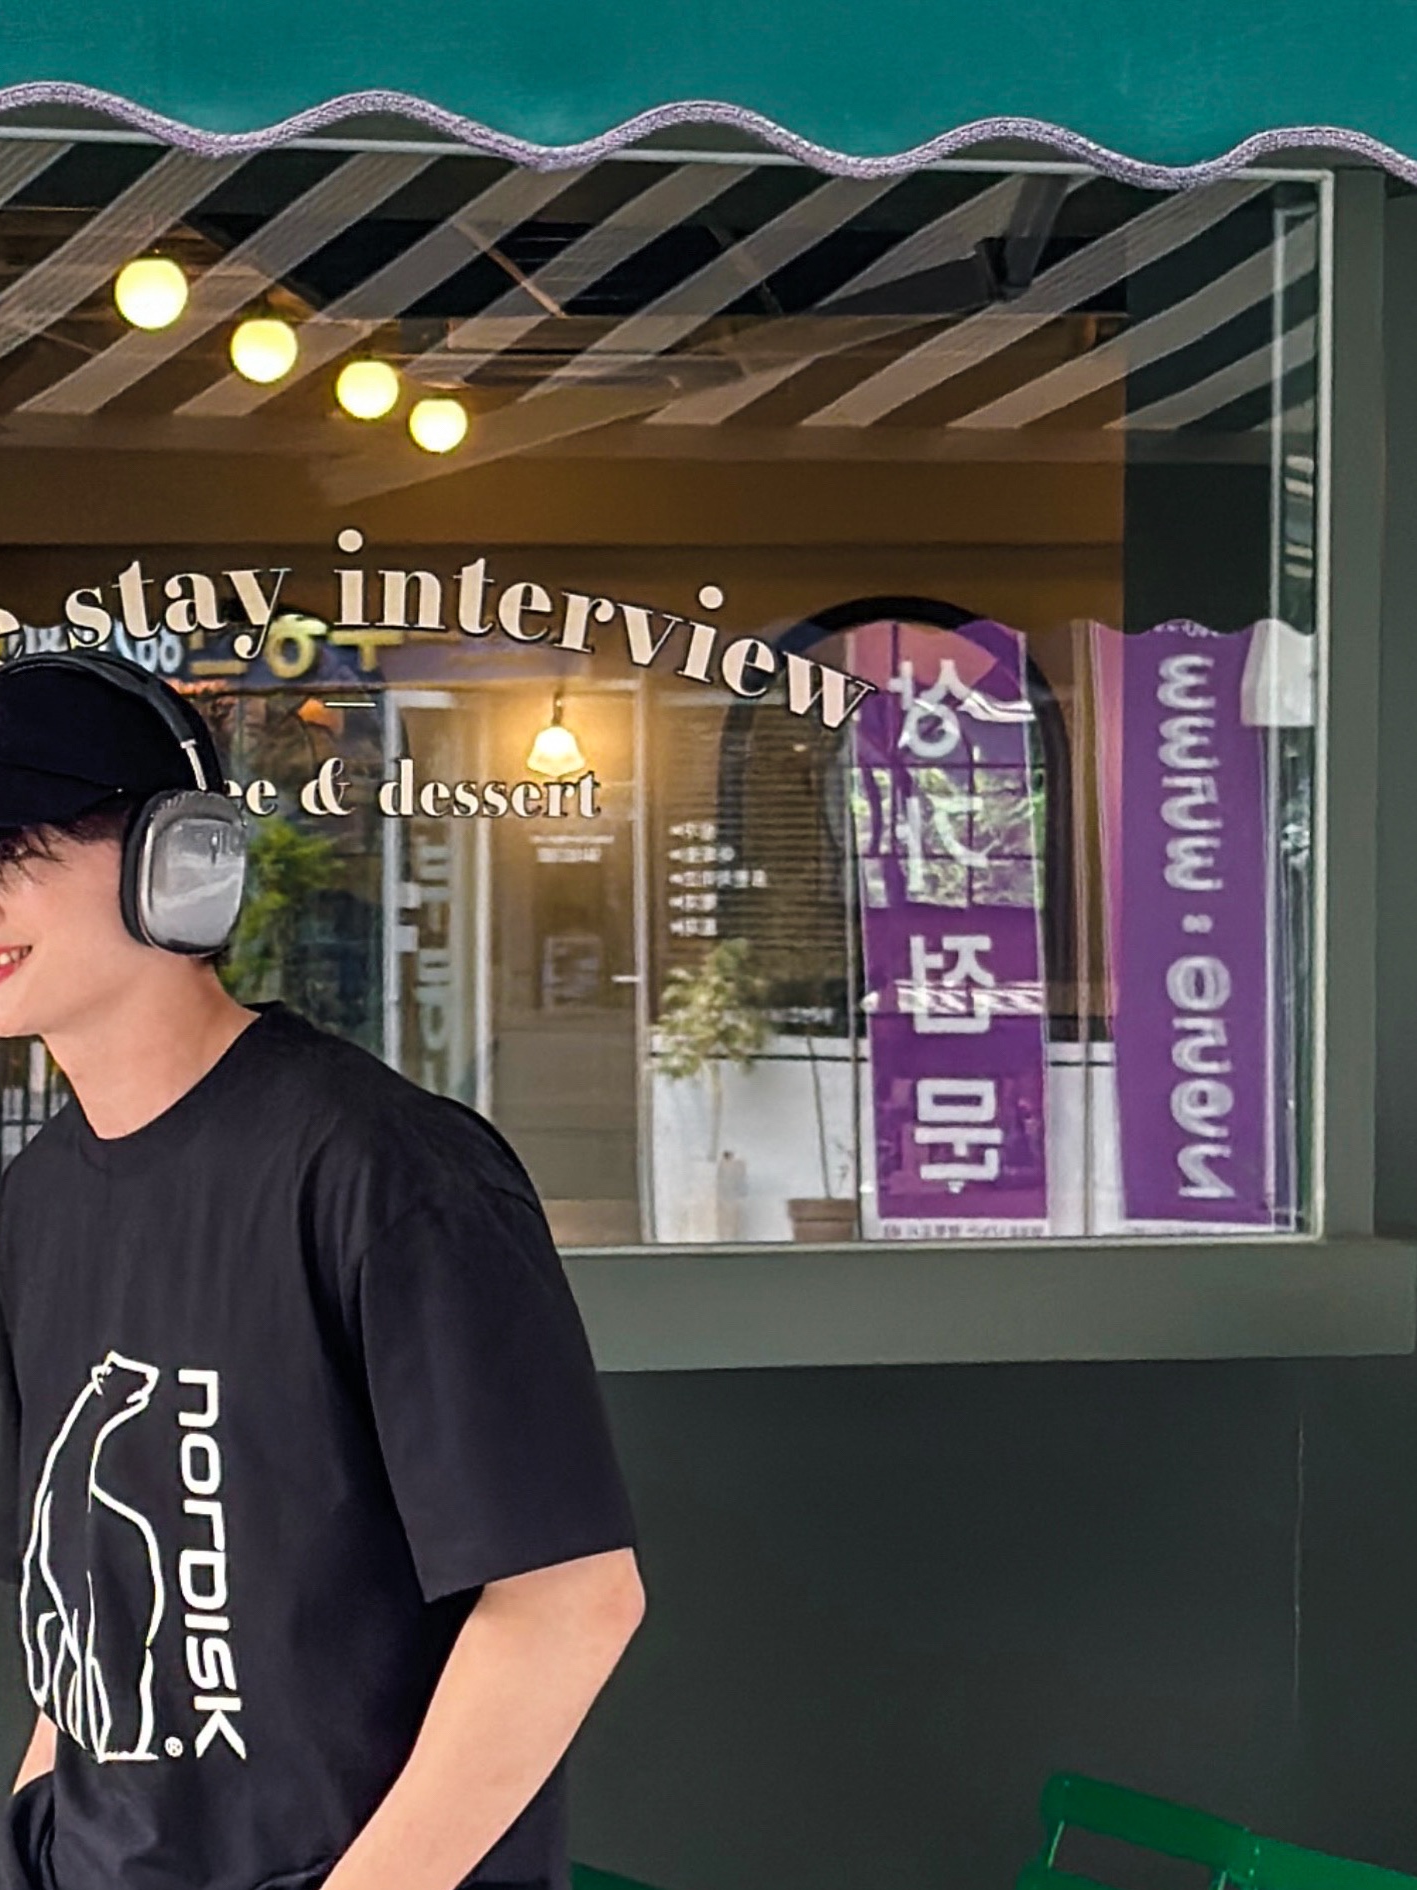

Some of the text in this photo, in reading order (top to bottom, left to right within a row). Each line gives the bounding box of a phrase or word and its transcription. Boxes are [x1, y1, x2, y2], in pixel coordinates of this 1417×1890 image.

[64, 560, 292, 658] stay
[333, 528, 877, 729] interview
[300, 757, 356, 817] &
[379, 757, 601, 818] dessert
